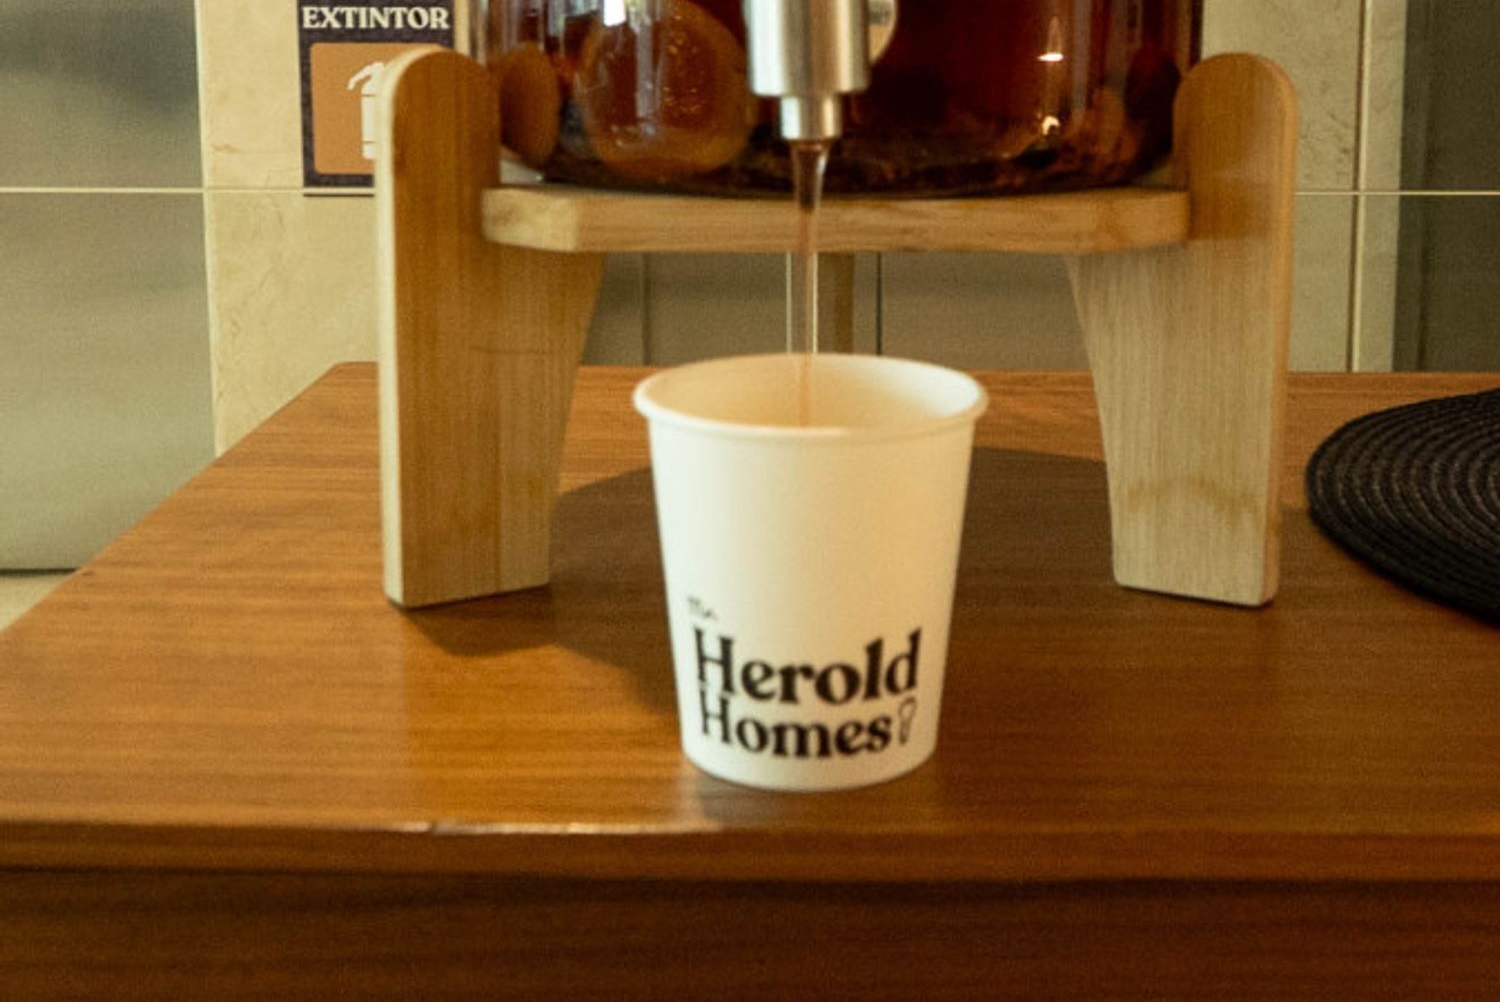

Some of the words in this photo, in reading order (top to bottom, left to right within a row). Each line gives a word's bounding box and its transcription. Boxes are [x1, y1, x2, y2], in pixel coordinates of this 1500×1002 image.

[301, 5, 450, 30] EXTINTOR
[693, 626, 923, 705] Herold
[700, 688, 893, 759] Homes
